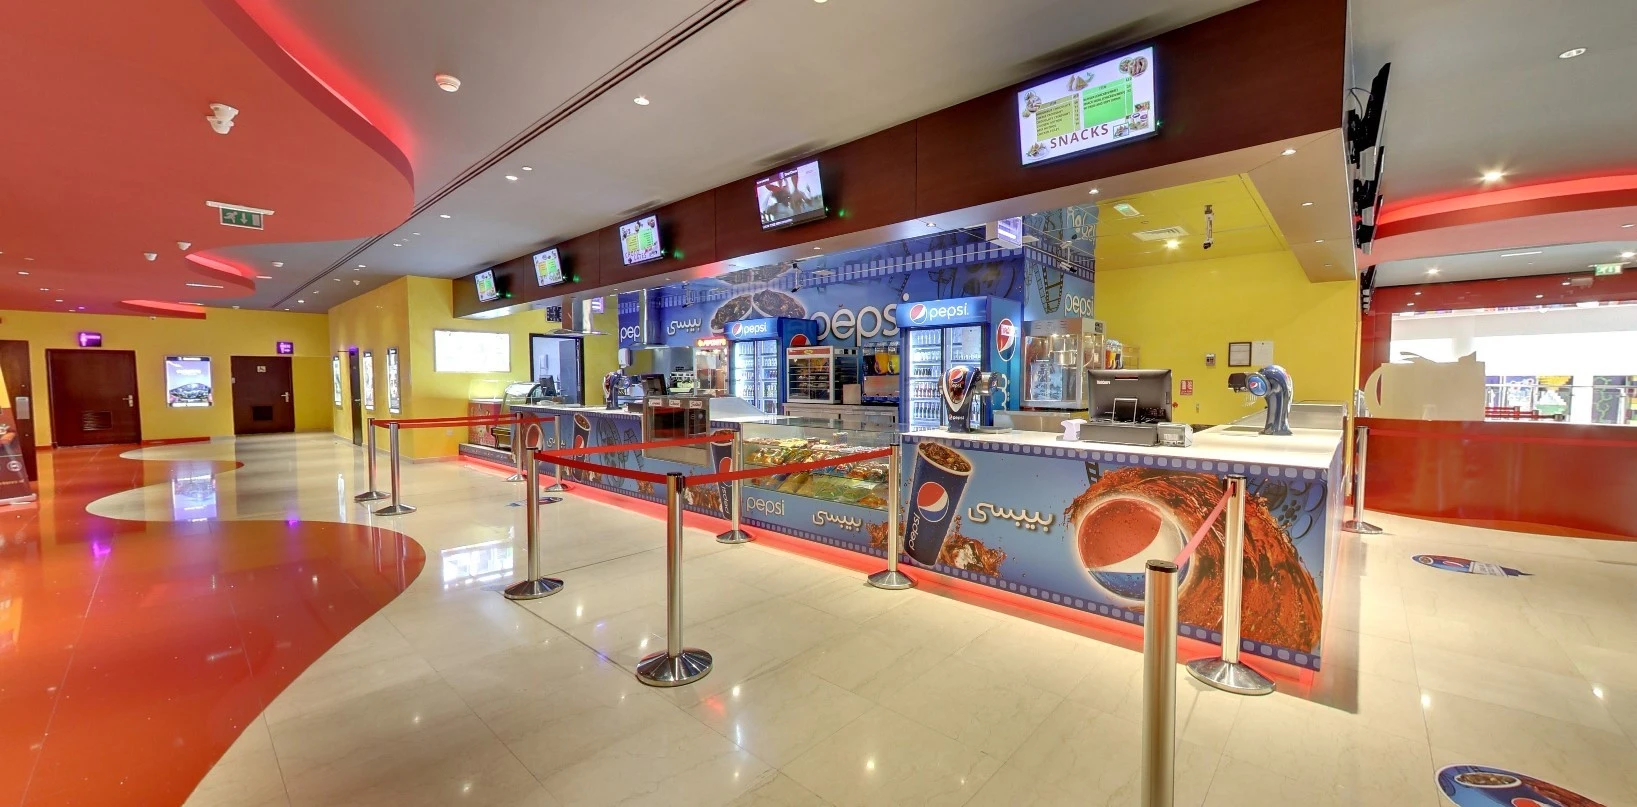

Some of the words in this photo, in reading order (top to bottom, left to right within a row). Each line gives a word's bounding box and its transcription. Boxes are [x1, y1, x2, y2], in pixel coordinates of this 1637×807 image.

[1050, 124, 1109, 149] SNACKS
[929, 302, 969, 321] pepsi
[1064, 293, 1094, 318] pepsi
[743, 322, 767, 336] pepsi
[810, 293, 909, 347] peps
[620, 325, 641, 343] pep
[746, 496, 785, 516] pepsi
[908, 512, 921, 551] pepsi
